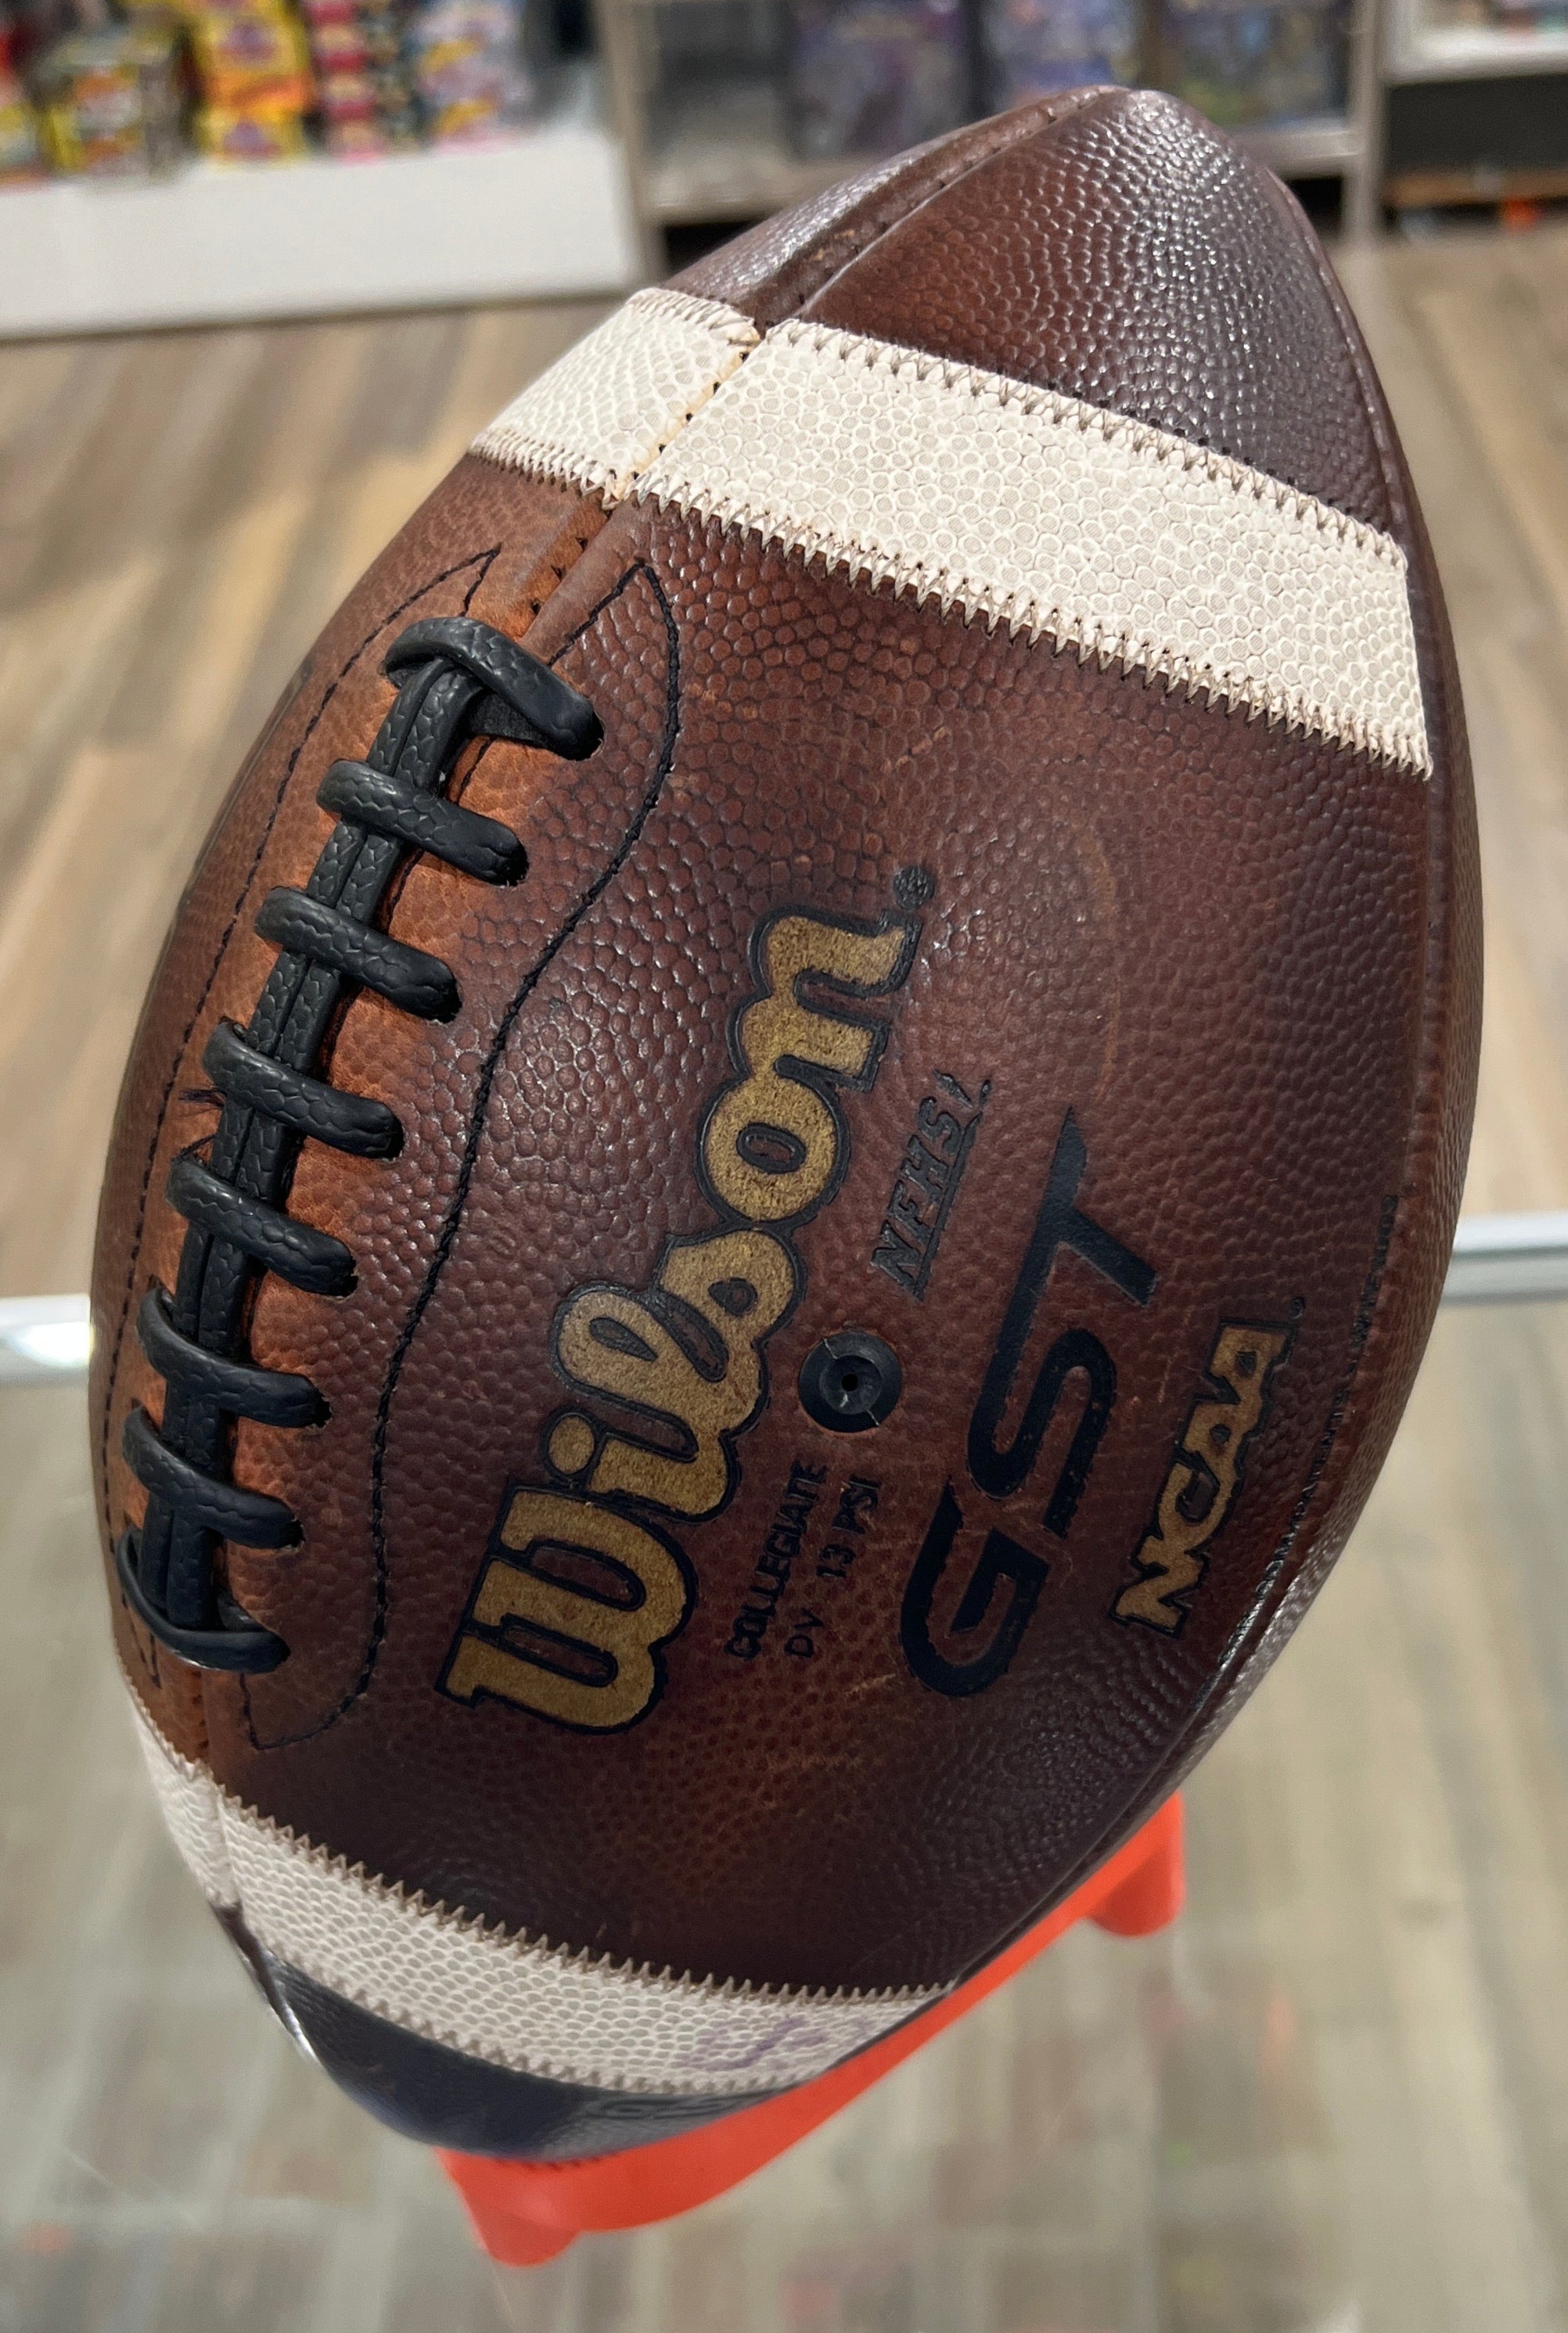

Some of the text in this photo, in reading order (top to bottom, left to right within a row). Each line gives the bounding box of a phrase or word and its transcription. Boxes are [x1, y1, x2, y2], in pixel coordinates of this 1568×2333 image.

[435, 907, 923, 1735] Wilson
[900, 1105, 1157, 1698] GST
[724, 1460, 828, 1661] COLLEGIATE
[815, 1543, 856, 1578] 13
[832, 1473, 883, 1536] PSI
[1109, 1318, 1300, 1637] NCAA
